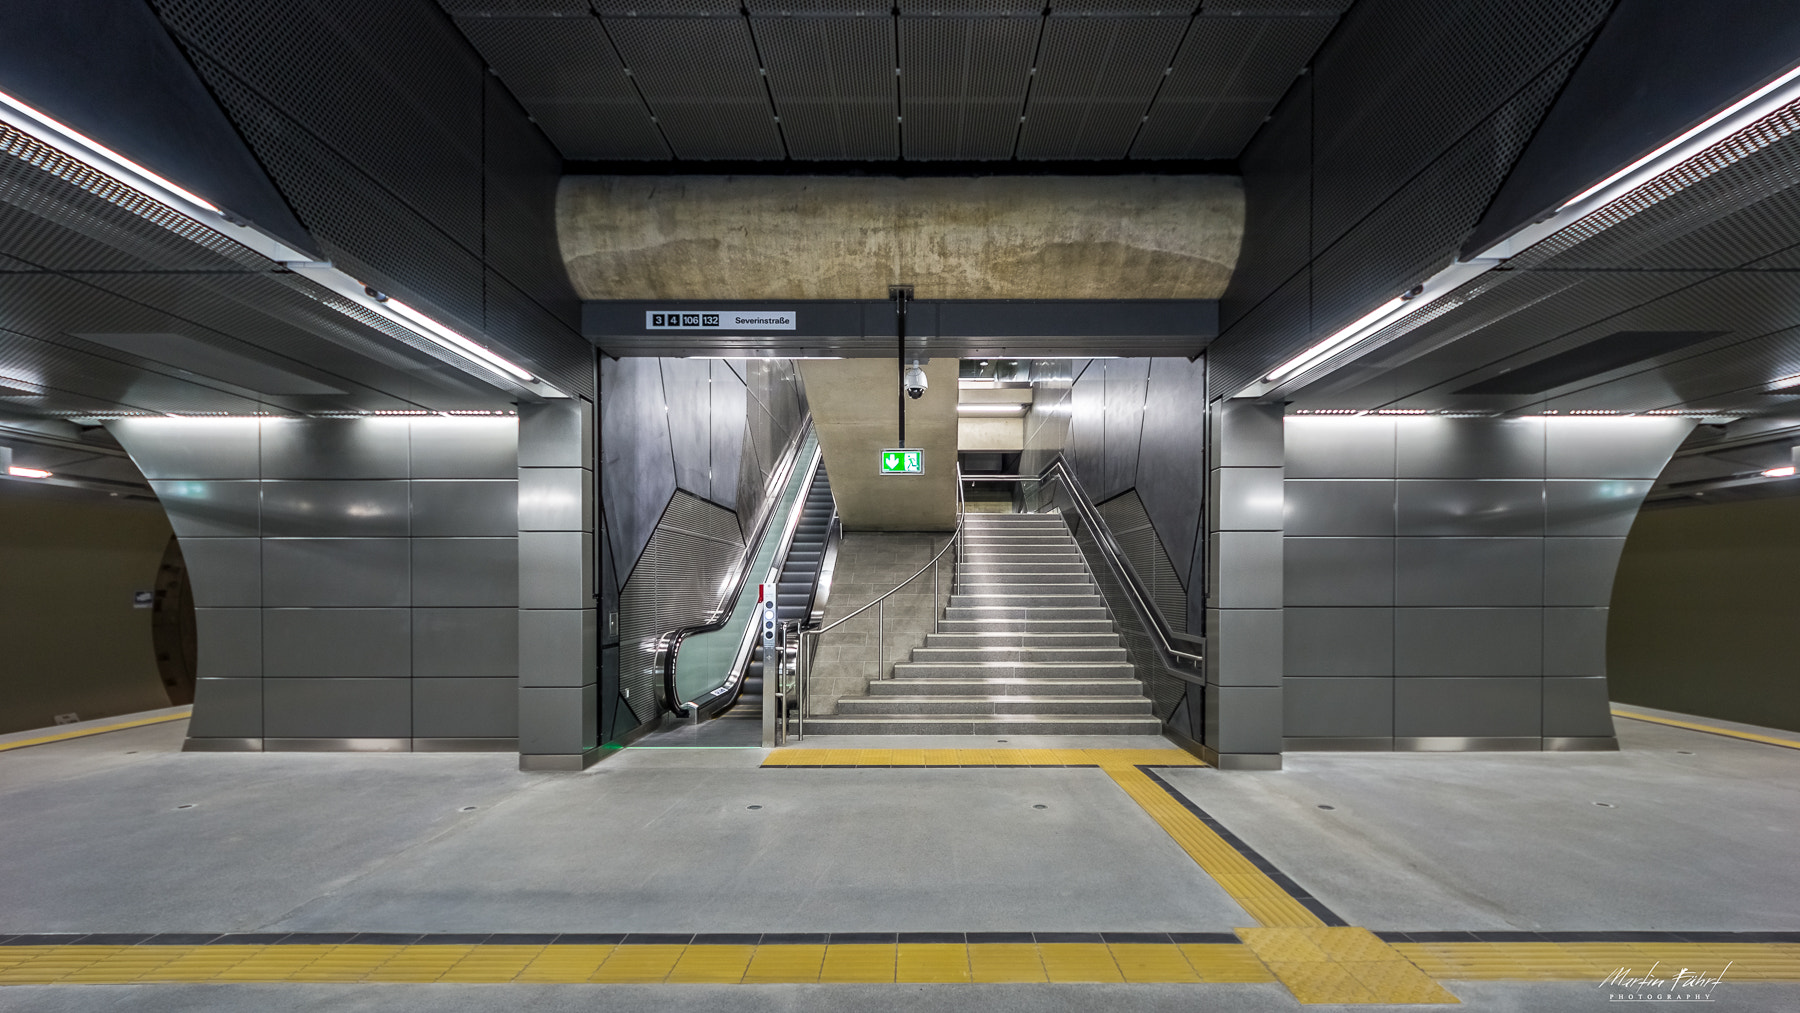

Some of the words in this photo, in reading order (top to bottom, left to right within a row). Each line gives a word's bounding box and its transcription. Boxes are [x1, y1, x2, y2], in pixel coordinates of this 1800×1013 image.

[655, 316, 662, 324] 3
[669, 316, 678, 324] 4
[683, 316, 699, 324] 106
[703, 316, 719, 324] 132
[735, 316, 790, 325] Severinstraße
